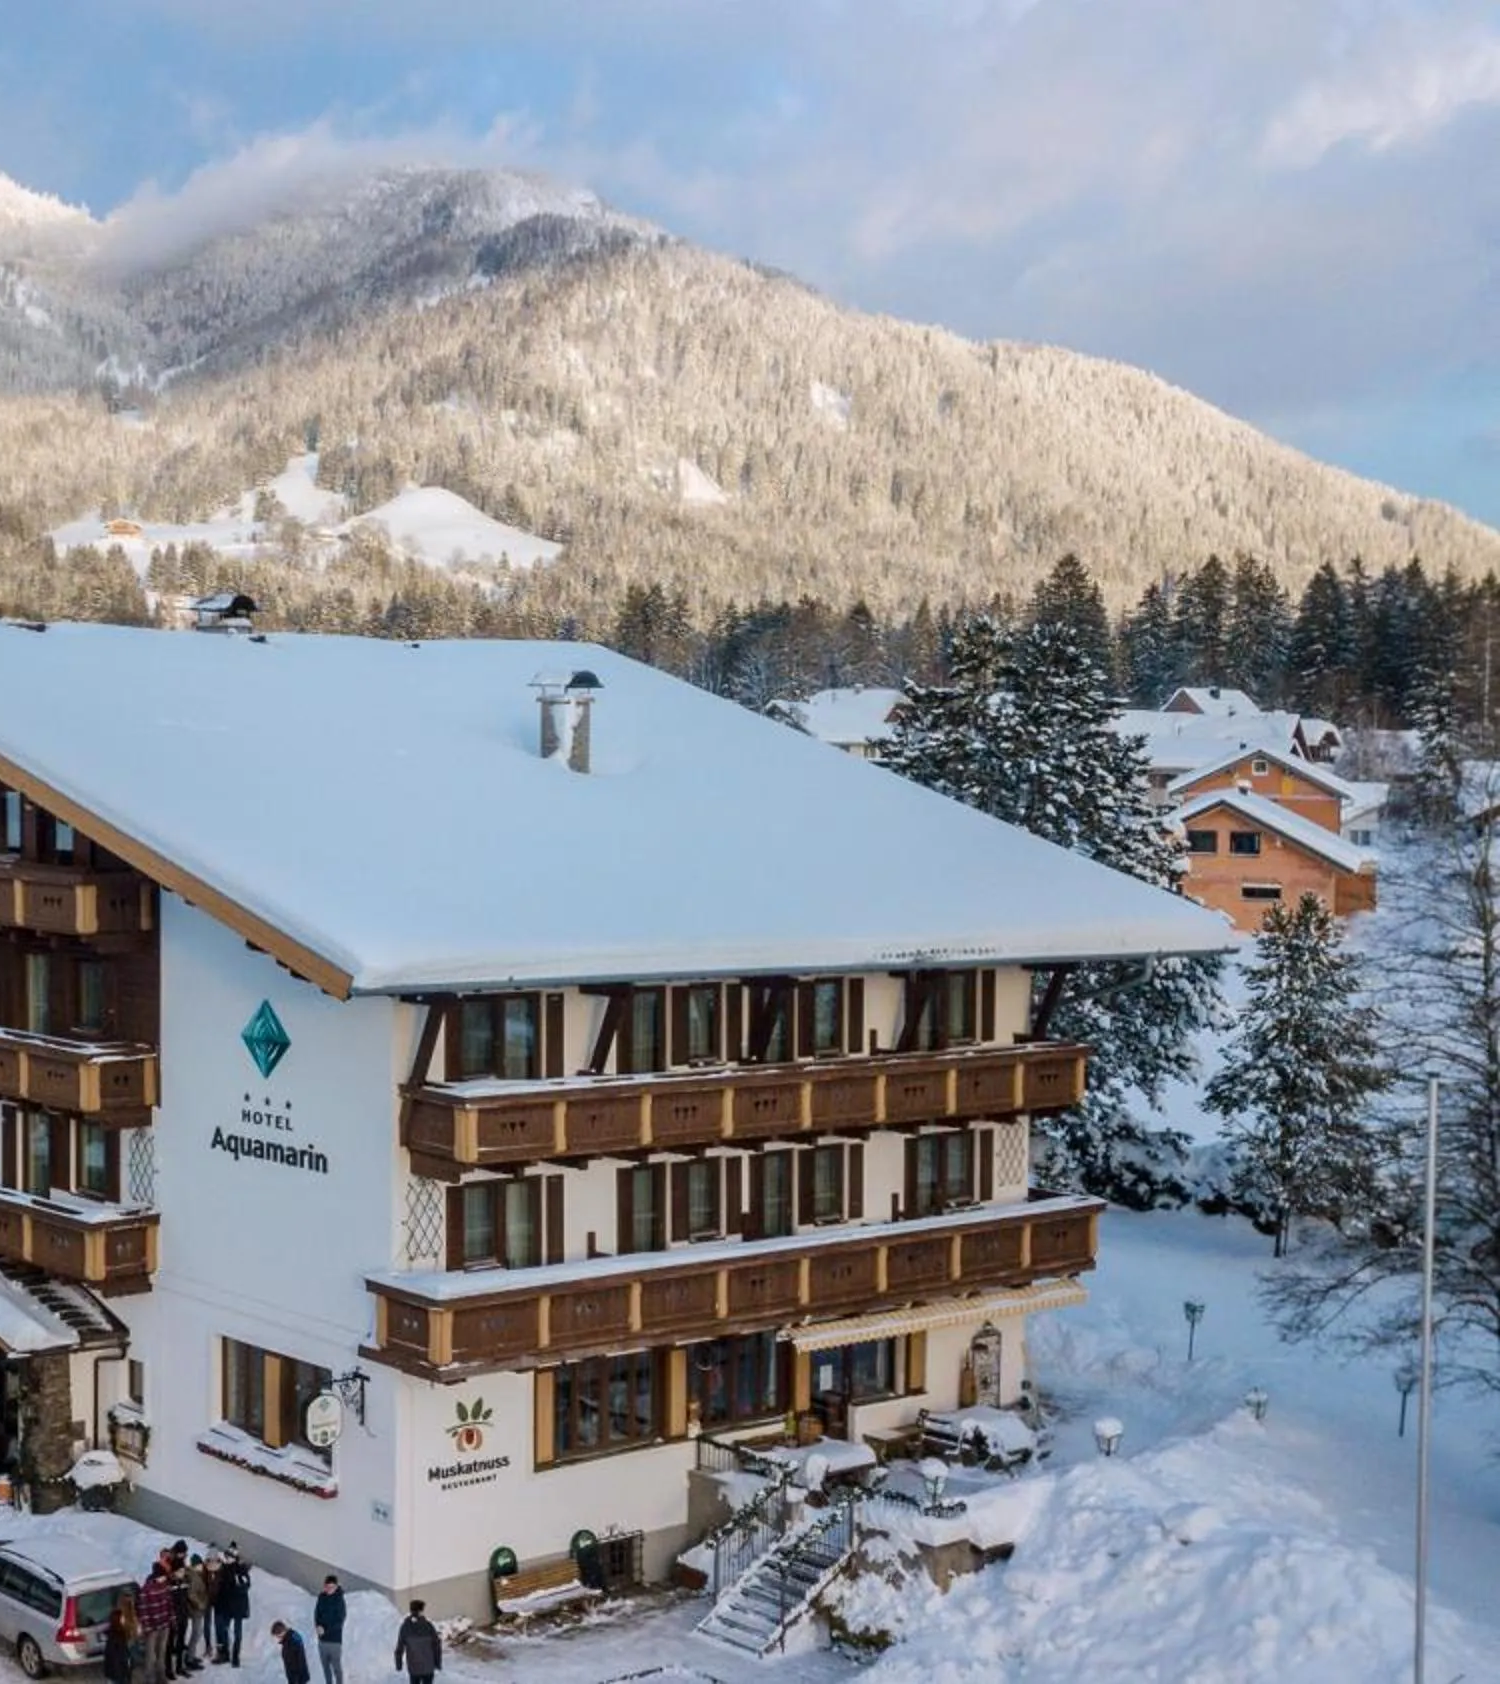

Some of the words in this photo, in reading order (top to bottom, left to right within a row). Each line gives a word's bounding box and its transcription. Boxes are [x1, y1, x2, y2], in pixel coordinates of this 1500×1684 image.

[241, 1108, 293, 1131] HOTEL
[211, 1126, 328, 1174] Aquamarin
[427, 1455, 510, 1482] Muskatnuss
